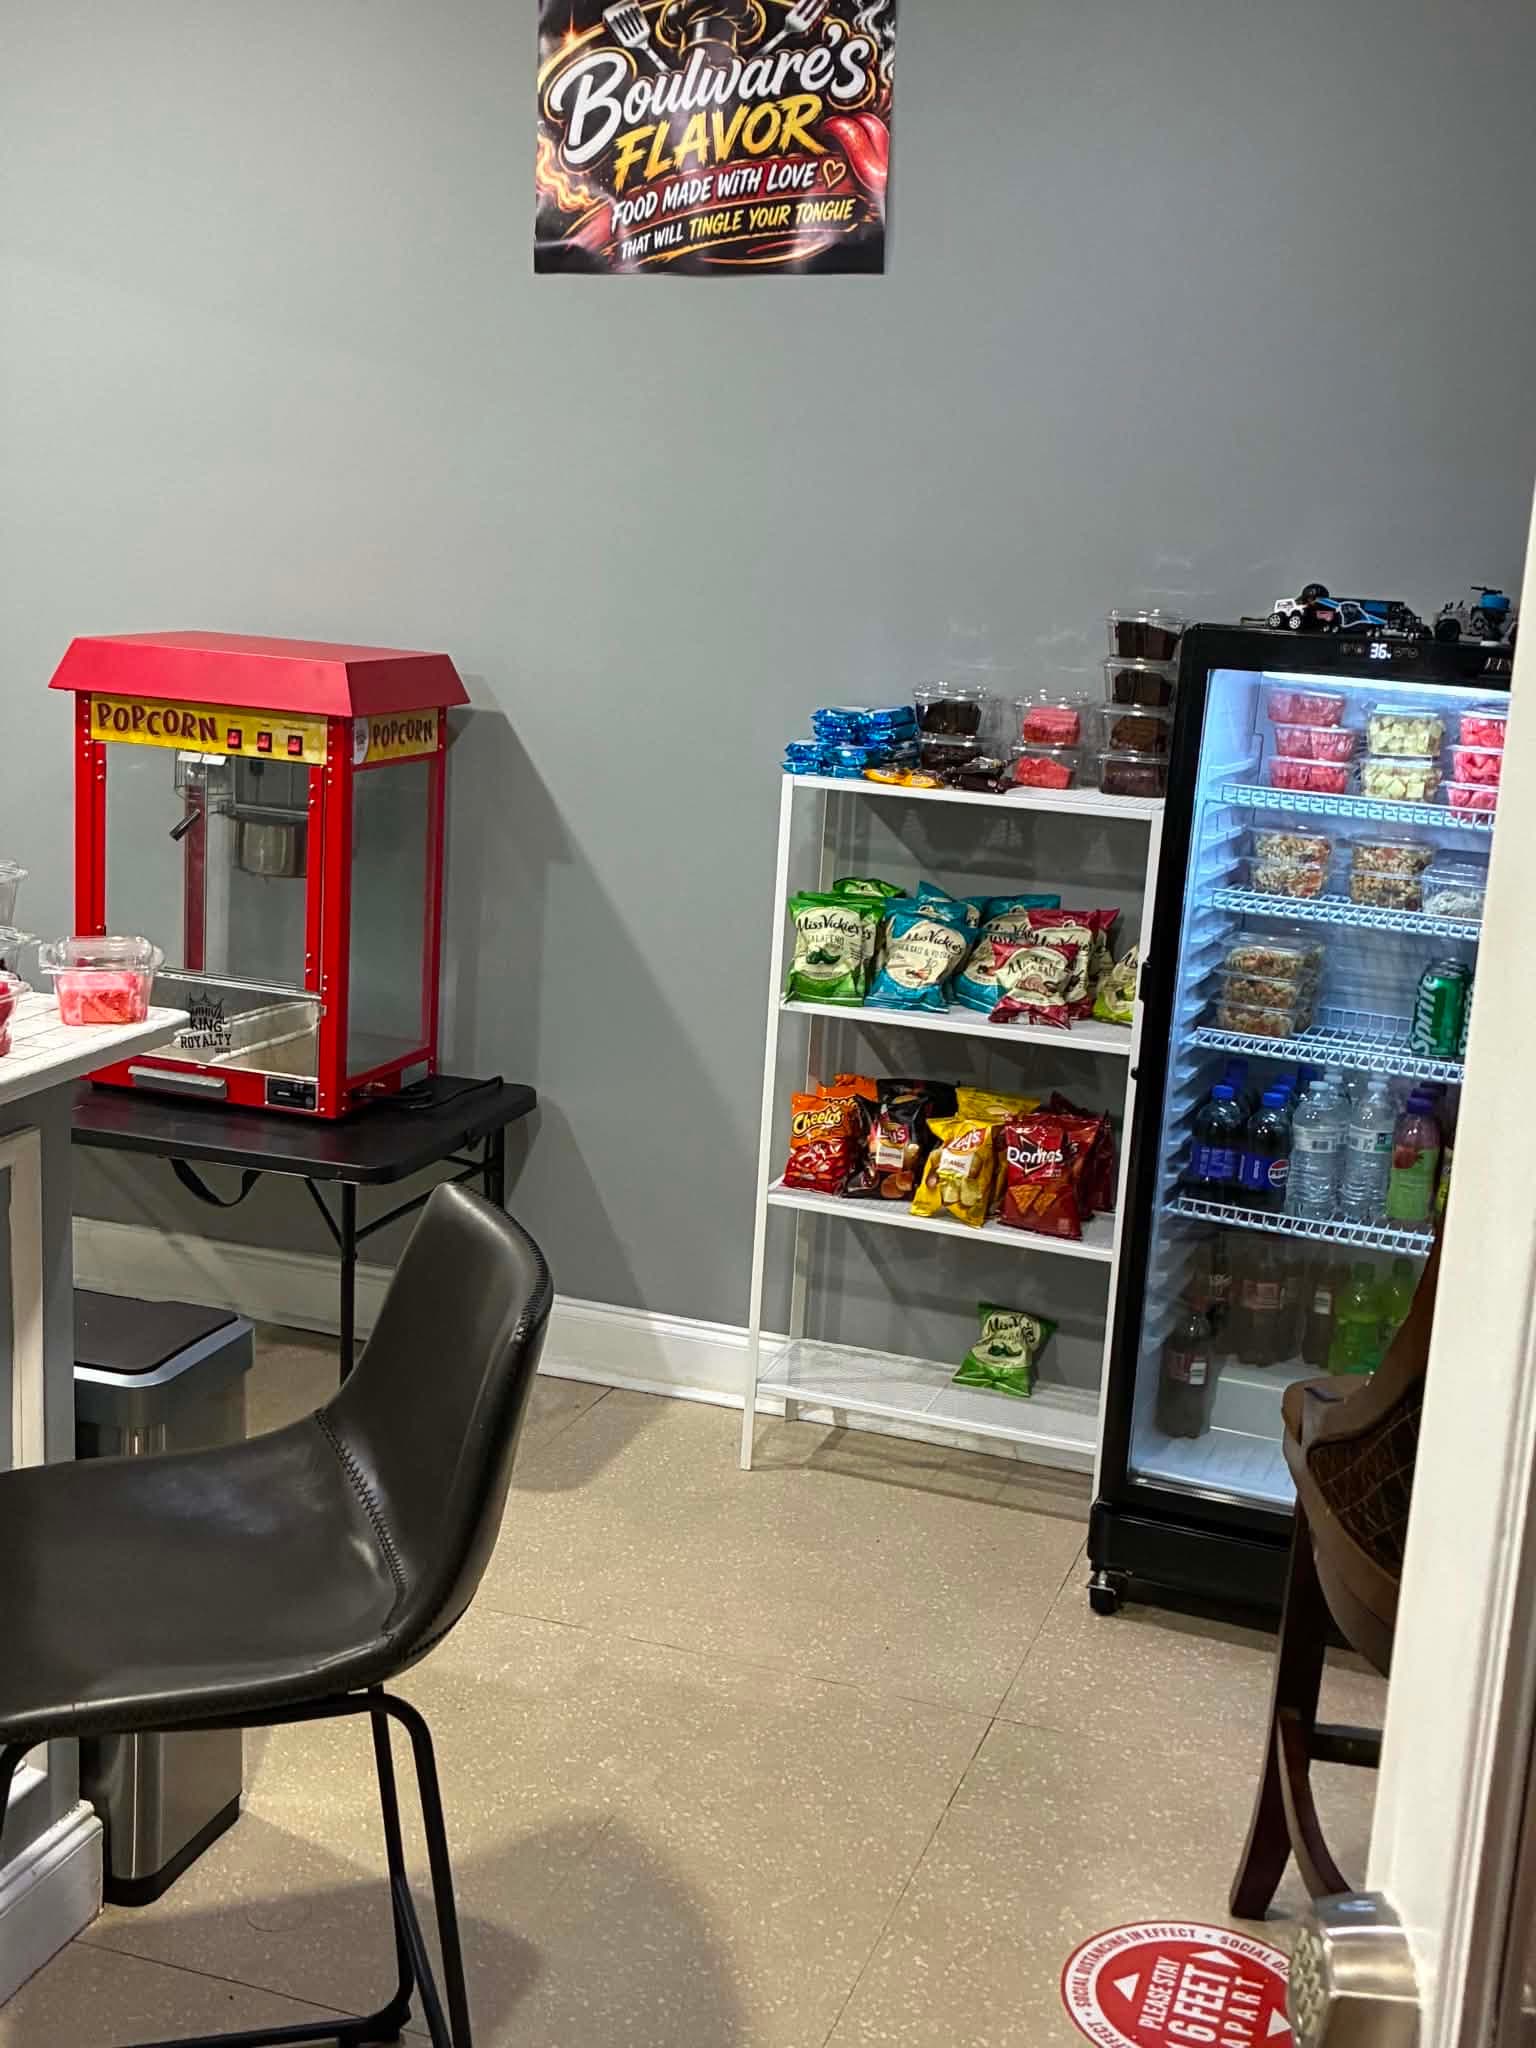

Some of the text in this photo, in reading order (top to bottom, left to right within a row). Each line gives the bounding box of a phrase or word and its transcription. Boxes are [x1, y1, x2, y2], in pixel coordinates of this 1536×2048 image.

[550, 21, 870, 165] Boulware's
[613, 95, 829, 193] FLAVOR
[611, 190, 658, 232] FOOD
[662, 176, 713, 213] MADE
[766, 162, 818, 191] LOVE
[621, 199, 856, 260] THAT WILL TINGLE YOUR TONGUE
[97, 703, 219, 744] POPCORN
[372, 719, 433, 748] POPCORN
[180, 1033, 232, 1048] ROYALTY
[191, 1017, 223, 1033] KING
[793, 1109, 842, 1136] Cheetos
[1007, 1146, 1064, 1165] Doritos
[1072, 1927, 1196, 2008] SOCIAL DISTANCING IN EFFECT
[1218, 1935, 1274, 1963] SOCIAL
[1137, 1955, 1182, 2031] PLEASE STAY
[1167, 1962, 1231, 2043] 6 FEET
[1219, 1975, 1265, 2048] APART
